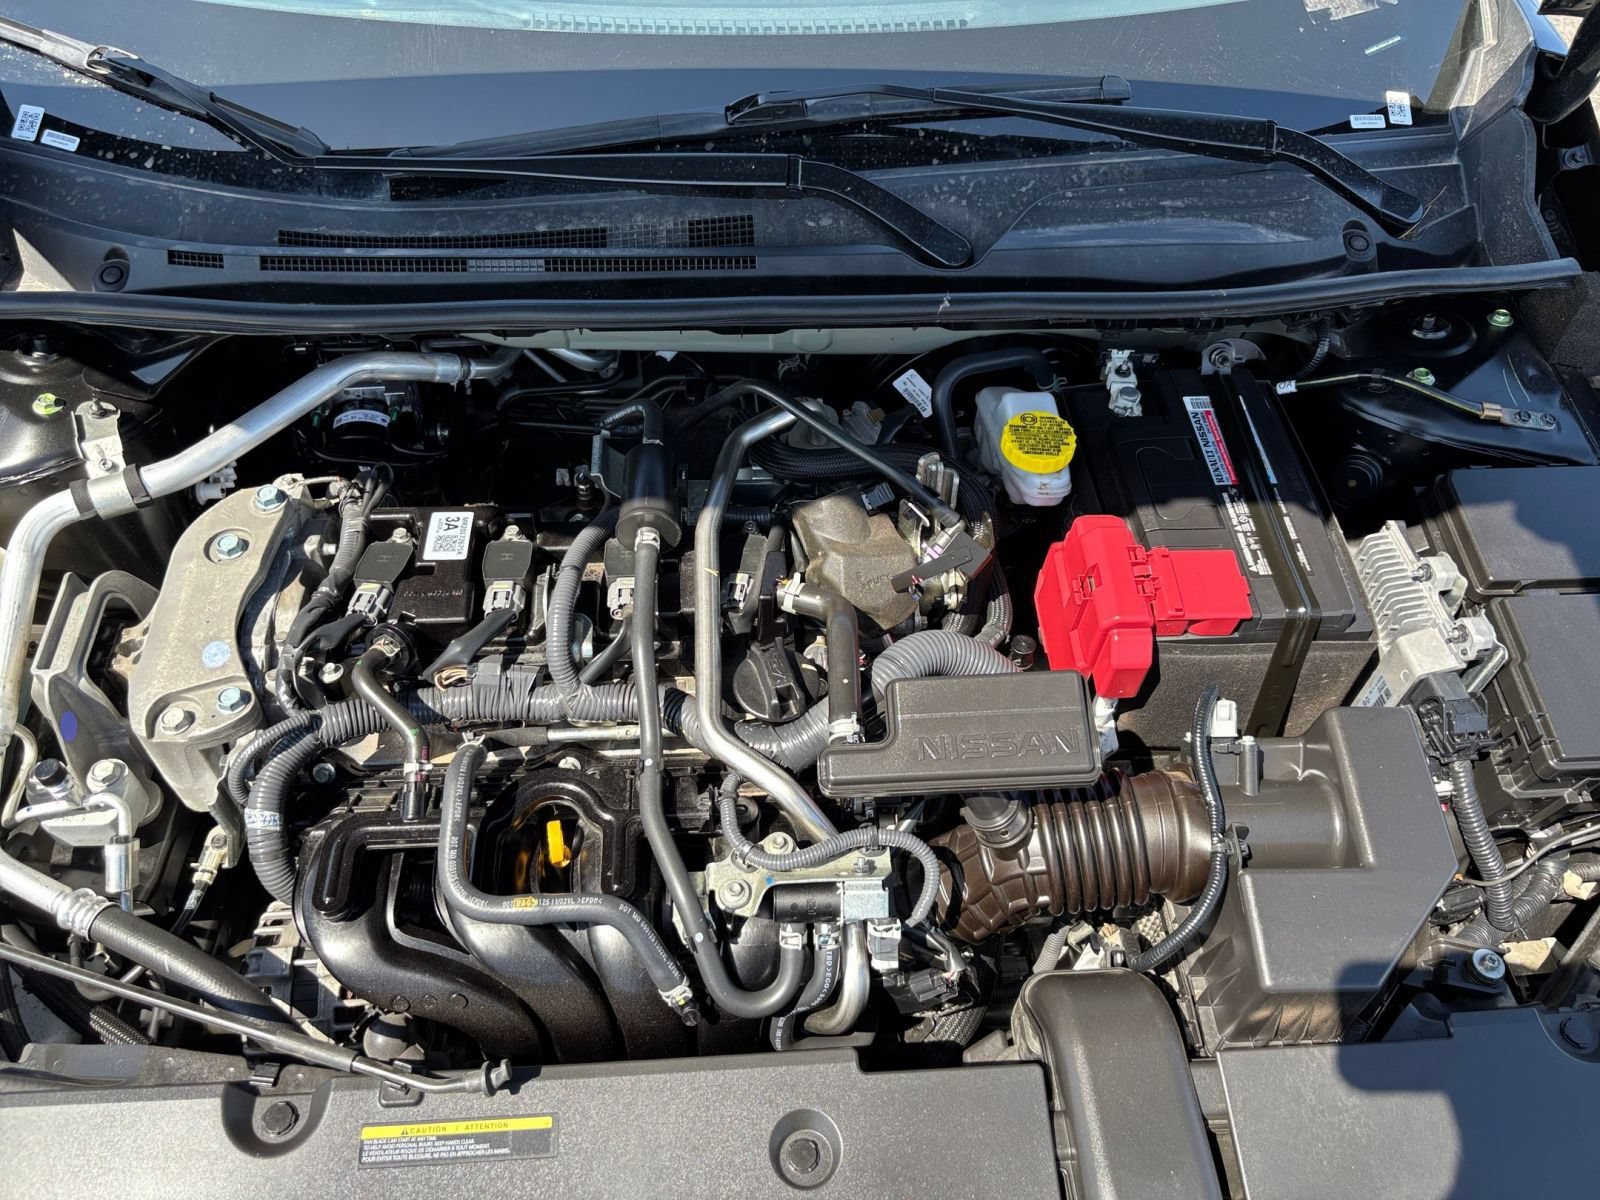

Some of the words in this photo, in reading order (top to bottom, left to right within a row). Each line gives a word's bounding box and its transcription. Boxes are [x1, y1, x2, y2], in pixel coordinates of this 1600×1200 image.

[1190, 412, 1211, 447] NISSAN
[1205, 450, 1225, 483] RENAULT
[443, 516, 460, 531] 3A
[916, 728, 1081, 760] NISSAN
[618, 903, 632, 913] DOT
[410, 1126, 447, 1134] CAUTION
[464, 1122, 509, 1131] ATTENTION
